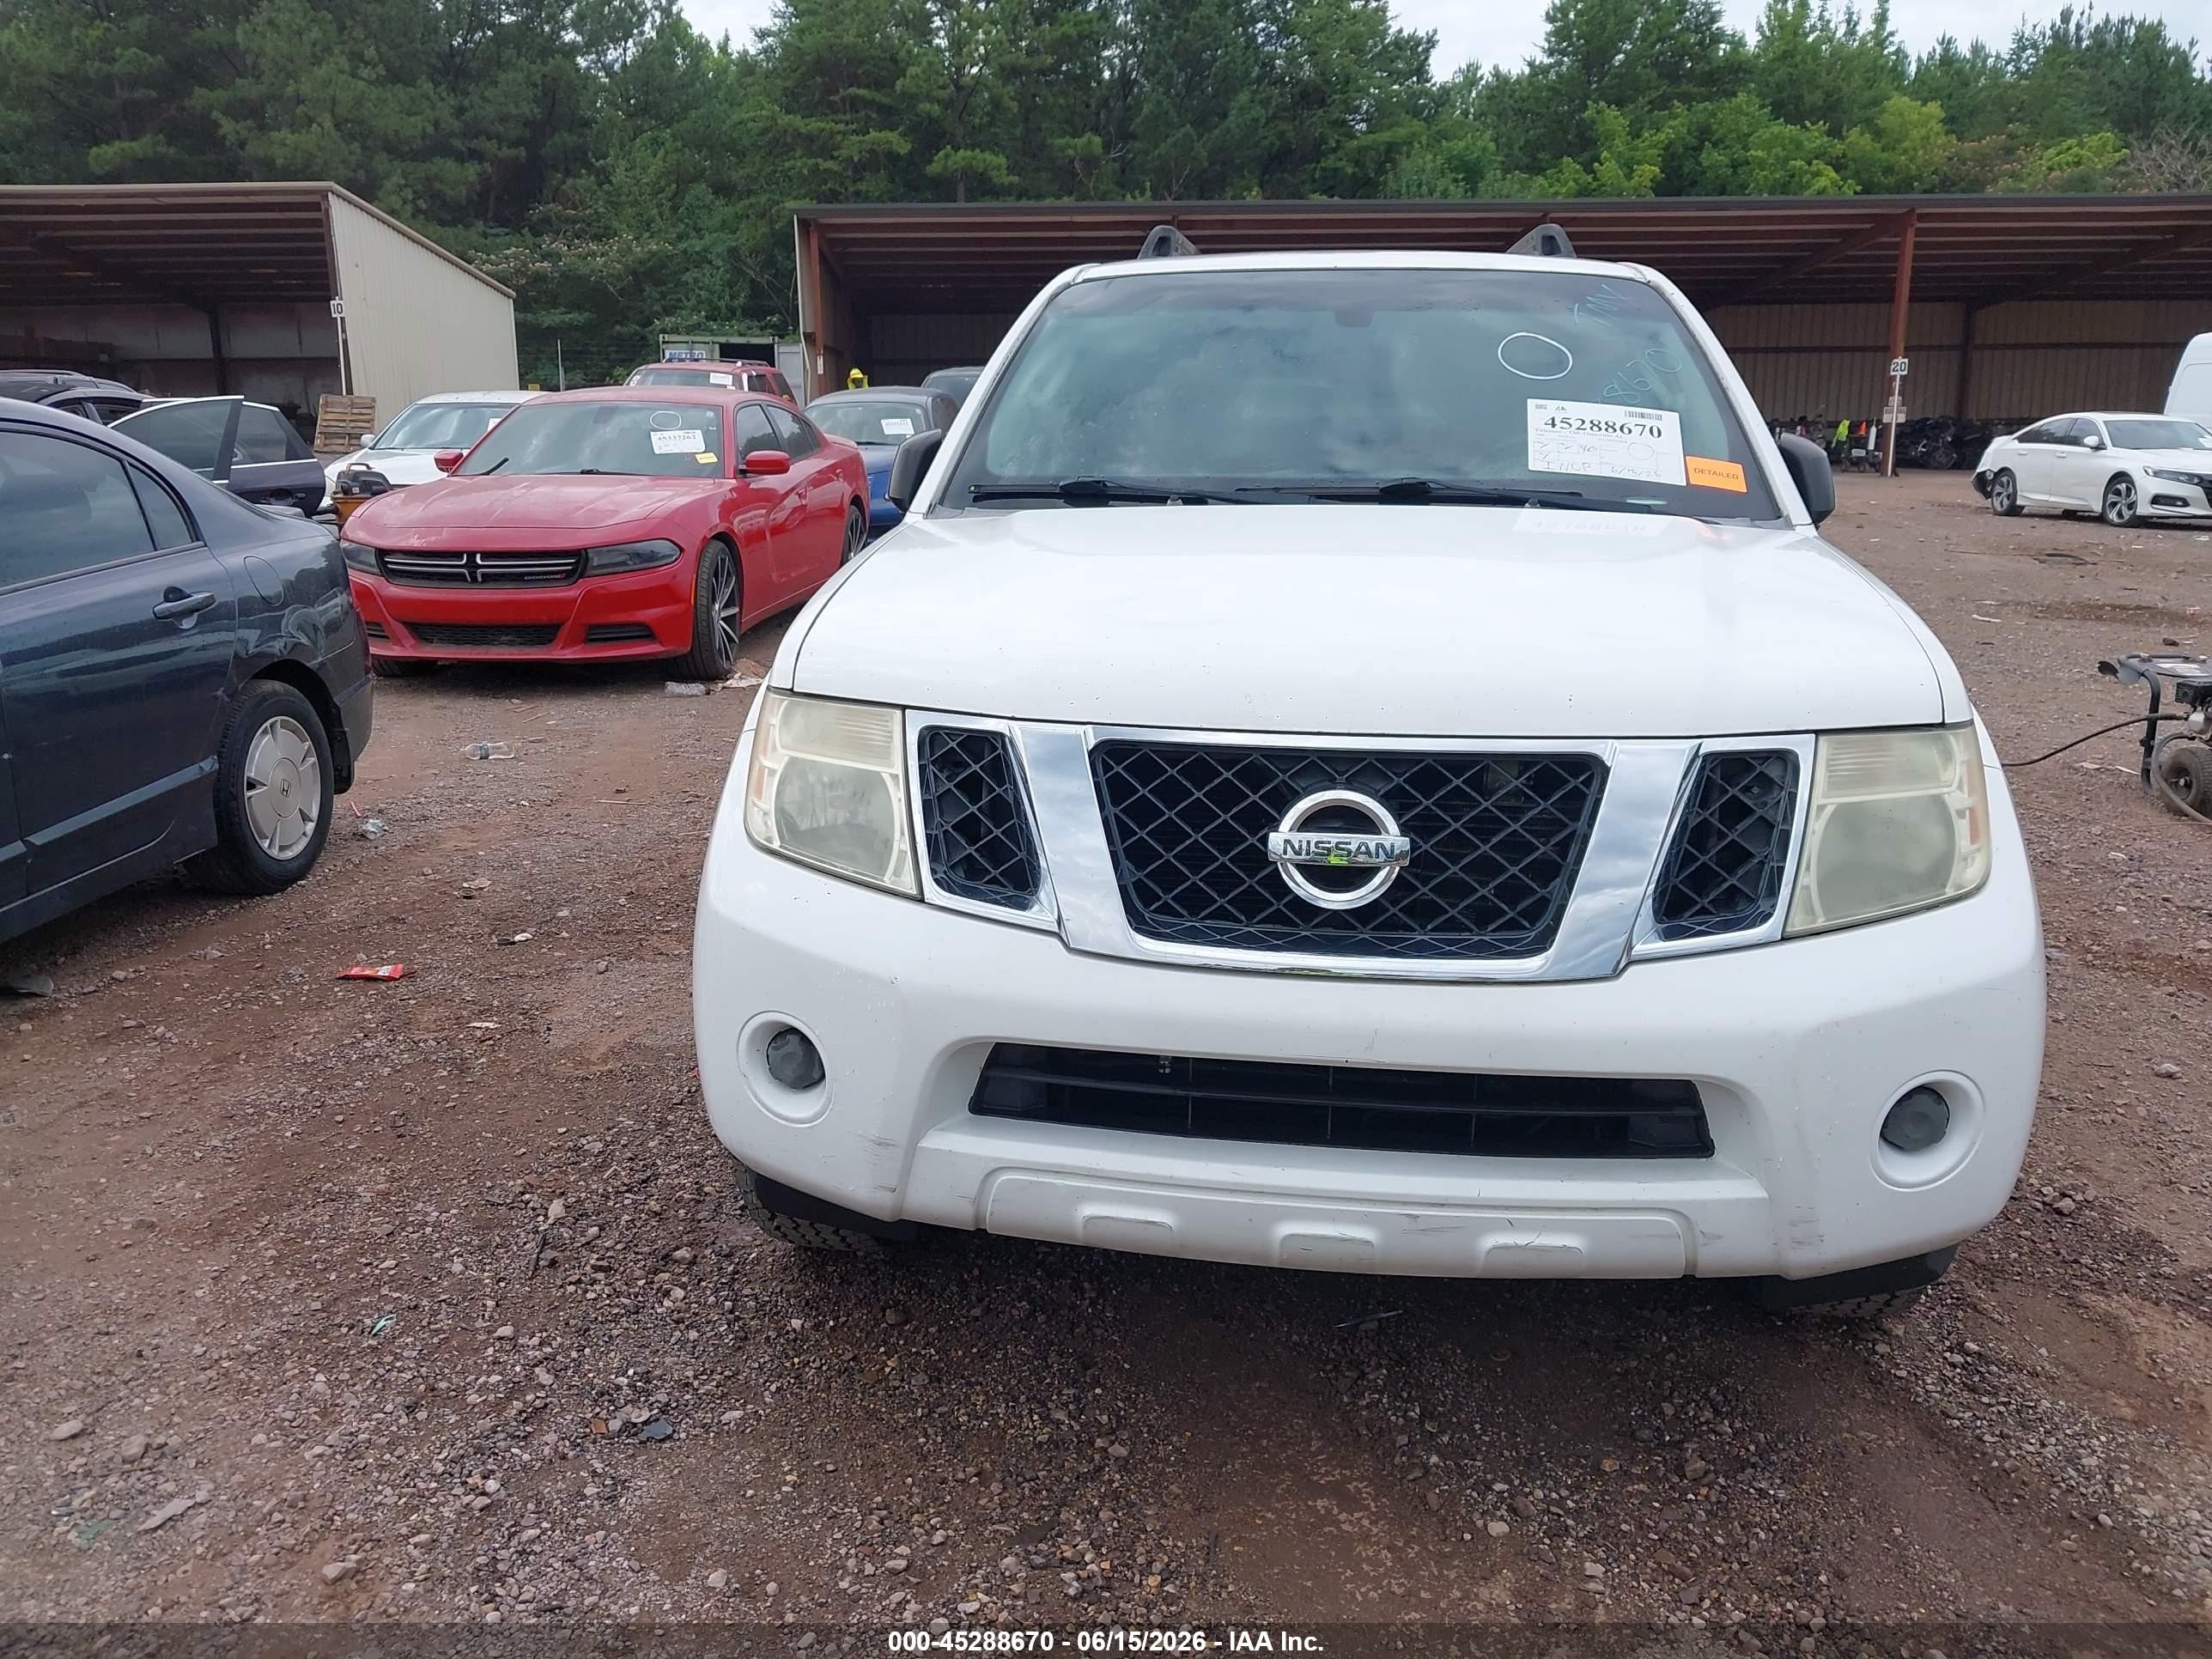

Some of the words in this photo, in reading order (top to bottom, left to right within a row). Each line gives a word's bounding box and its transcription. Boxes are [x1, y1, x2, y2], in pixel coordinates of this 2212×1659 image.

[331, 302, 343, 314] 10
[1892, 361, 1906, 373] 20
[1543, 416, 1662, 439] 45288670
[1693, 467, 1740, 480] DETAILED
[1282, 838, 1396, 860] NISSAN
